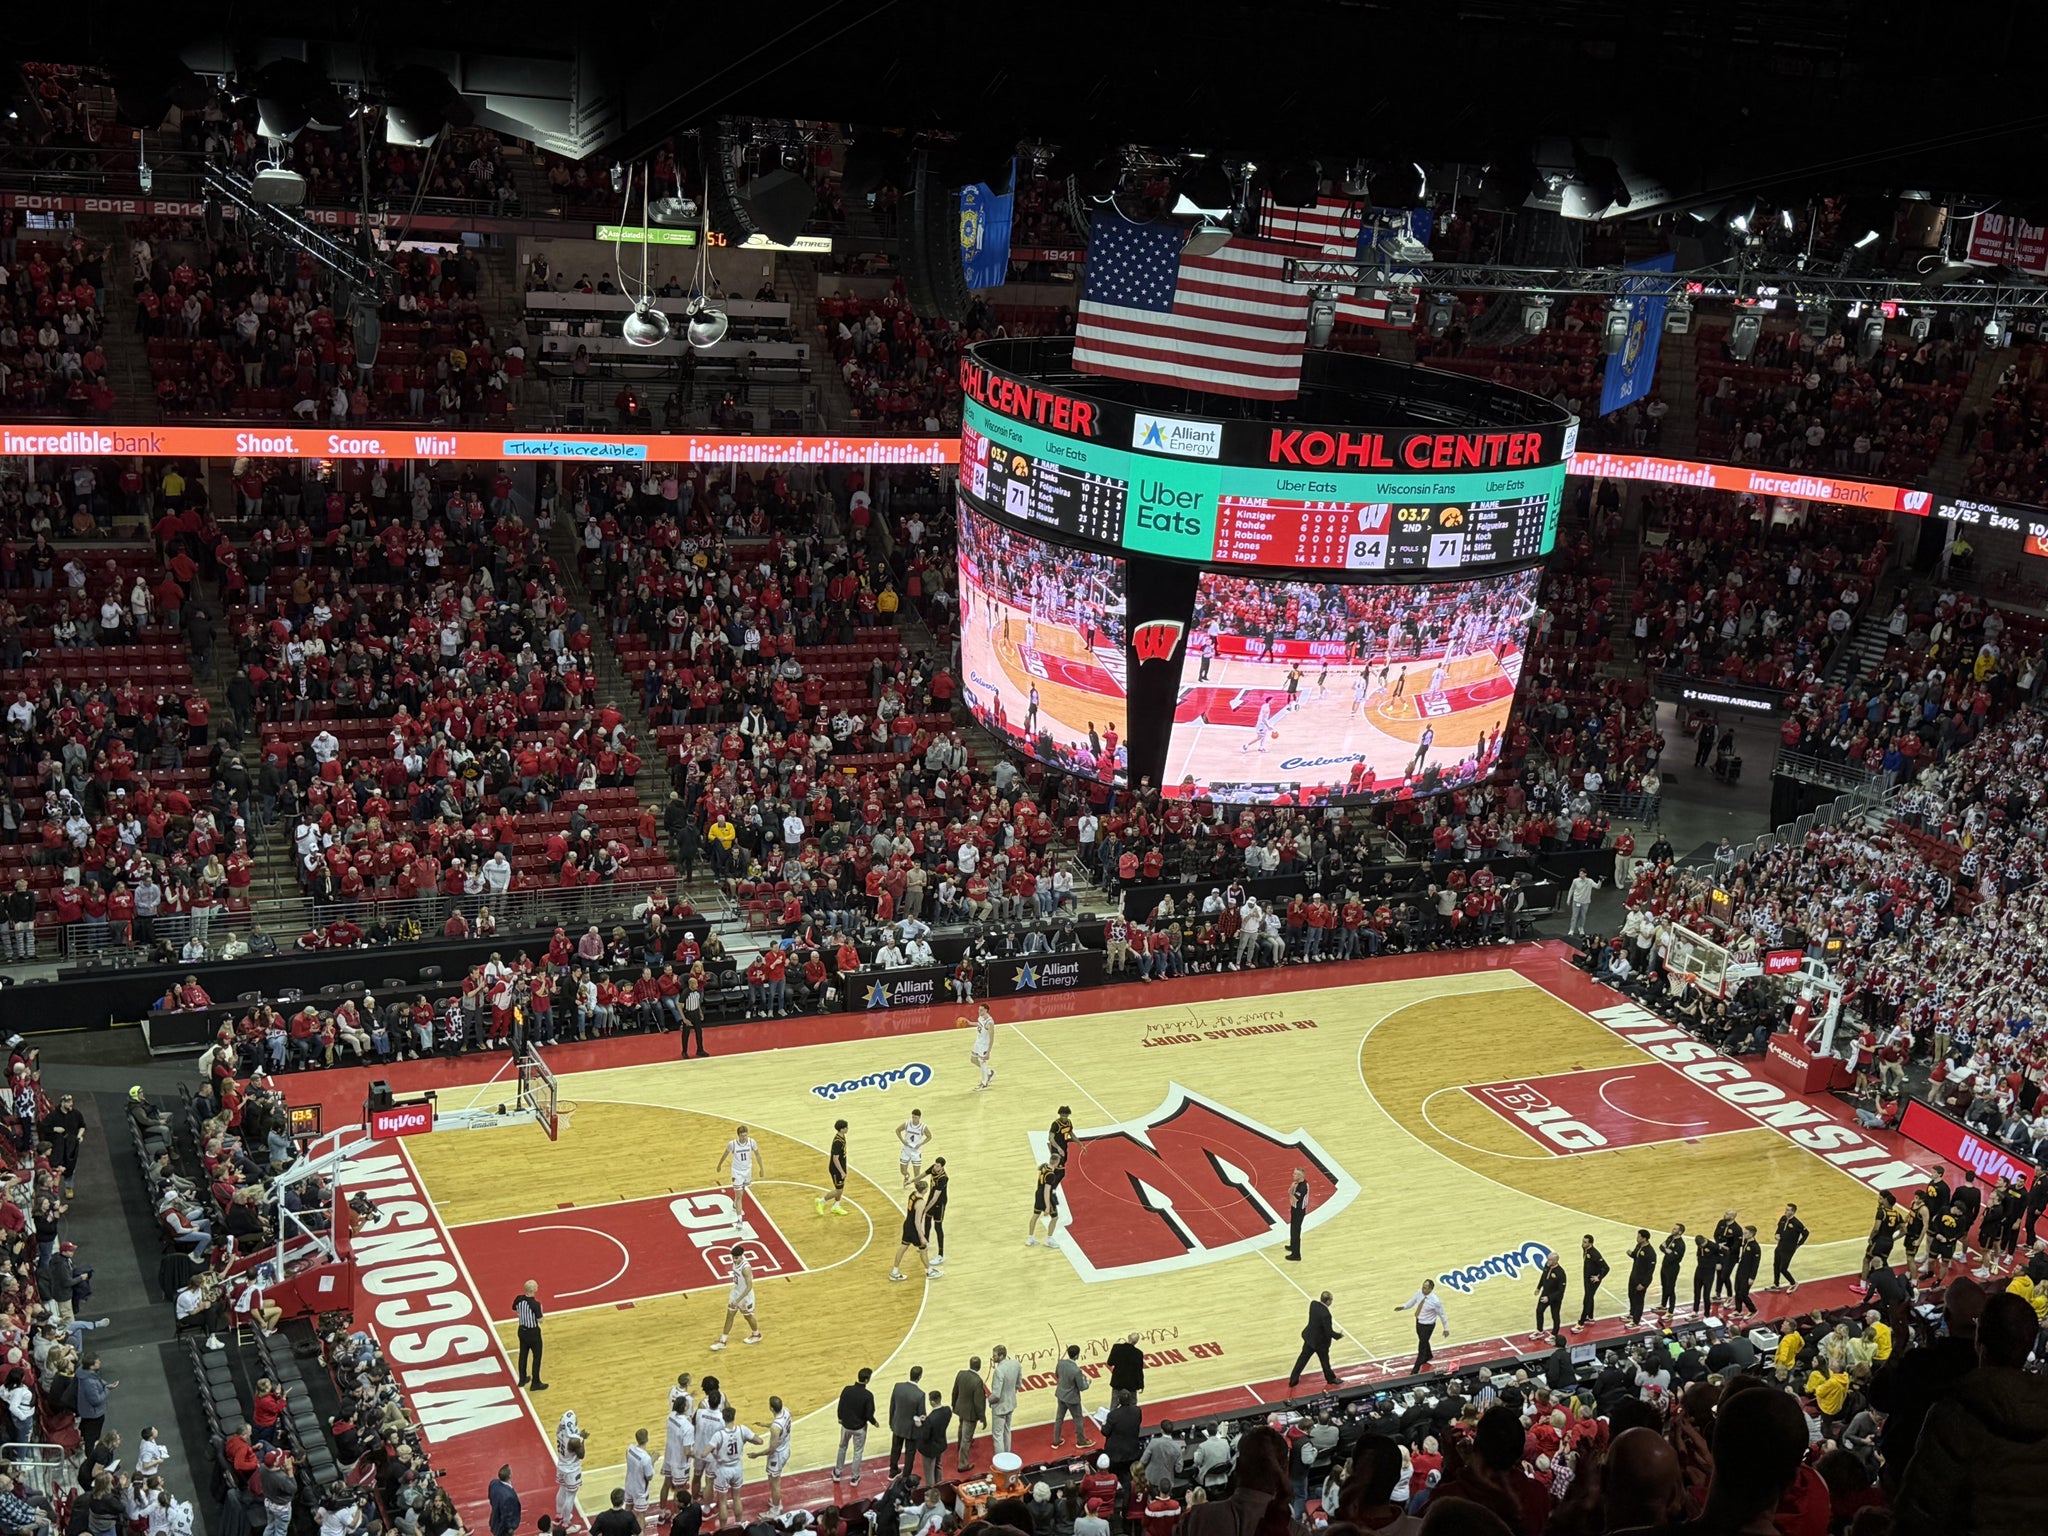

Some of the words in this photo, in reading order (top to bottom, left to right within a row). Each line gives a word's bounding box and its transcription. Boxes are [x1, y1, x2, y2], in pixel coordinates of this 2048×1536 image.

[15, 196, 62, 210] 2011
[85, 200, 135, 213] 2012
[154, 202, 202, 216] 2014
[1042, 250, 1076, 261] 1941
[988, 376, 1092, 437] CENTER
[1008, 428, 1023, 443] Fans
[1171, 426, 1215, 442] Alliant
[4, 432, 162, 453] incrediblebank
[236, 433, 299, 453] Shoot.
[328, 434, 385, 455] Score.
[415, 436, 457, 456] Win!
[511, 443, 559, 456] That's
[563, 443, 638, 457] incredible.
[1268, 428, 1394, 467] KOHL
[1404, 432, 1542, 469] CENTER
[991, 446, 1008, 463] 03.7
[1046, 441, 1065, 456] Uber
[1066, 447, 1087, 462] Eats
[1041, 460, 1059, 472] NAME
[1276, 479, 1305, 492] Uber
[1308, 479, 1337, 493] Eats
[1377, 483, 1431, 495] Wisconsin
[1433, 483, 1456, 494] Fans
[1486, 481, 1505, 492] Uber
[1506, 480, 1525, 490] Eats
[1749, 473, 1869, 503] incrediblebank
[1012, 487, 1024, 506] 71
[1140, 479, 1203, 509] Uber
[1239, 497, 1268, 506] NAME
[1304, 501, 1311, 509] P
[1318, 502, 1324, 510] R
[1330, 502, 1337, 510] A
[1344, 503, 1350, 511] F
[1481, 501, 1499, 509] NAME
[1955, 500, 1977, 510] FIELD
[1978, 504, 1999, 514] GOAL
[1137, 505, 1200, 535] Eats
[1237, 510, 1276, 520] Kinziger
[1398, 508, 1430, 521] 03.7
[1938, 505, 1980, 523] 28/52
[1989, 514, 2020, 530] 54%
[1236, 521, 1266, 529] Rohde
[1301, 524, 1307, 532] 6
[1314, 525, 1320, 533] 2
[1327, 525, 1333, 533] 4
[1341, 525, 1347, 533] 2
[1402, 524, 1421, 532] 2ND
[1221, 529, 1228, 537] 11
[1235, 531, 1272, 540] Robison
[1299, 534, 1306, 542] 0
[1313, 535, 1319, 543] 0
[1326, 535, 1332, 543] 0
[1339, 535, 1346, 543] 0
[1219, 540, 1228, 548] 13
[1233, 541, 1260, 550] Jones
[1354, 541, 1380, 557] 84
[1439, 540, 1456, 557] 71
[1216, 550, 1228, 558] 22
[1232, 551, 1257, 561] Rapp
[1698, 692, 1729, 703] UNDER
[1730, 698, 1772, 710] ARMOUR
[1042, 961, 1079, 975] Alliant
[894, 979, 933, 993] Alliant
[1204, 1023, 1292, 1040] NICHOLAS
[1292, 1019, 1318, 1029] AB
[1142, 1033, 1202, 1048] COURT
[1774, 1046, 1808, 1069] MUELLER
[813, 1062, 932, 1099] Culver's
[1588, 1003, 1933, 1190] WISCONSIN
[292, 1109, 312, 1120] 03.5
[379, 1114, 425, 1132] HyVee
[740, 1153, 747, 1161] 11
[1440, 1242, 1552, 1292] Culver's
[1189, 1341, 1224, 1359] AB
[727, 1442, 738, 1455] 31
